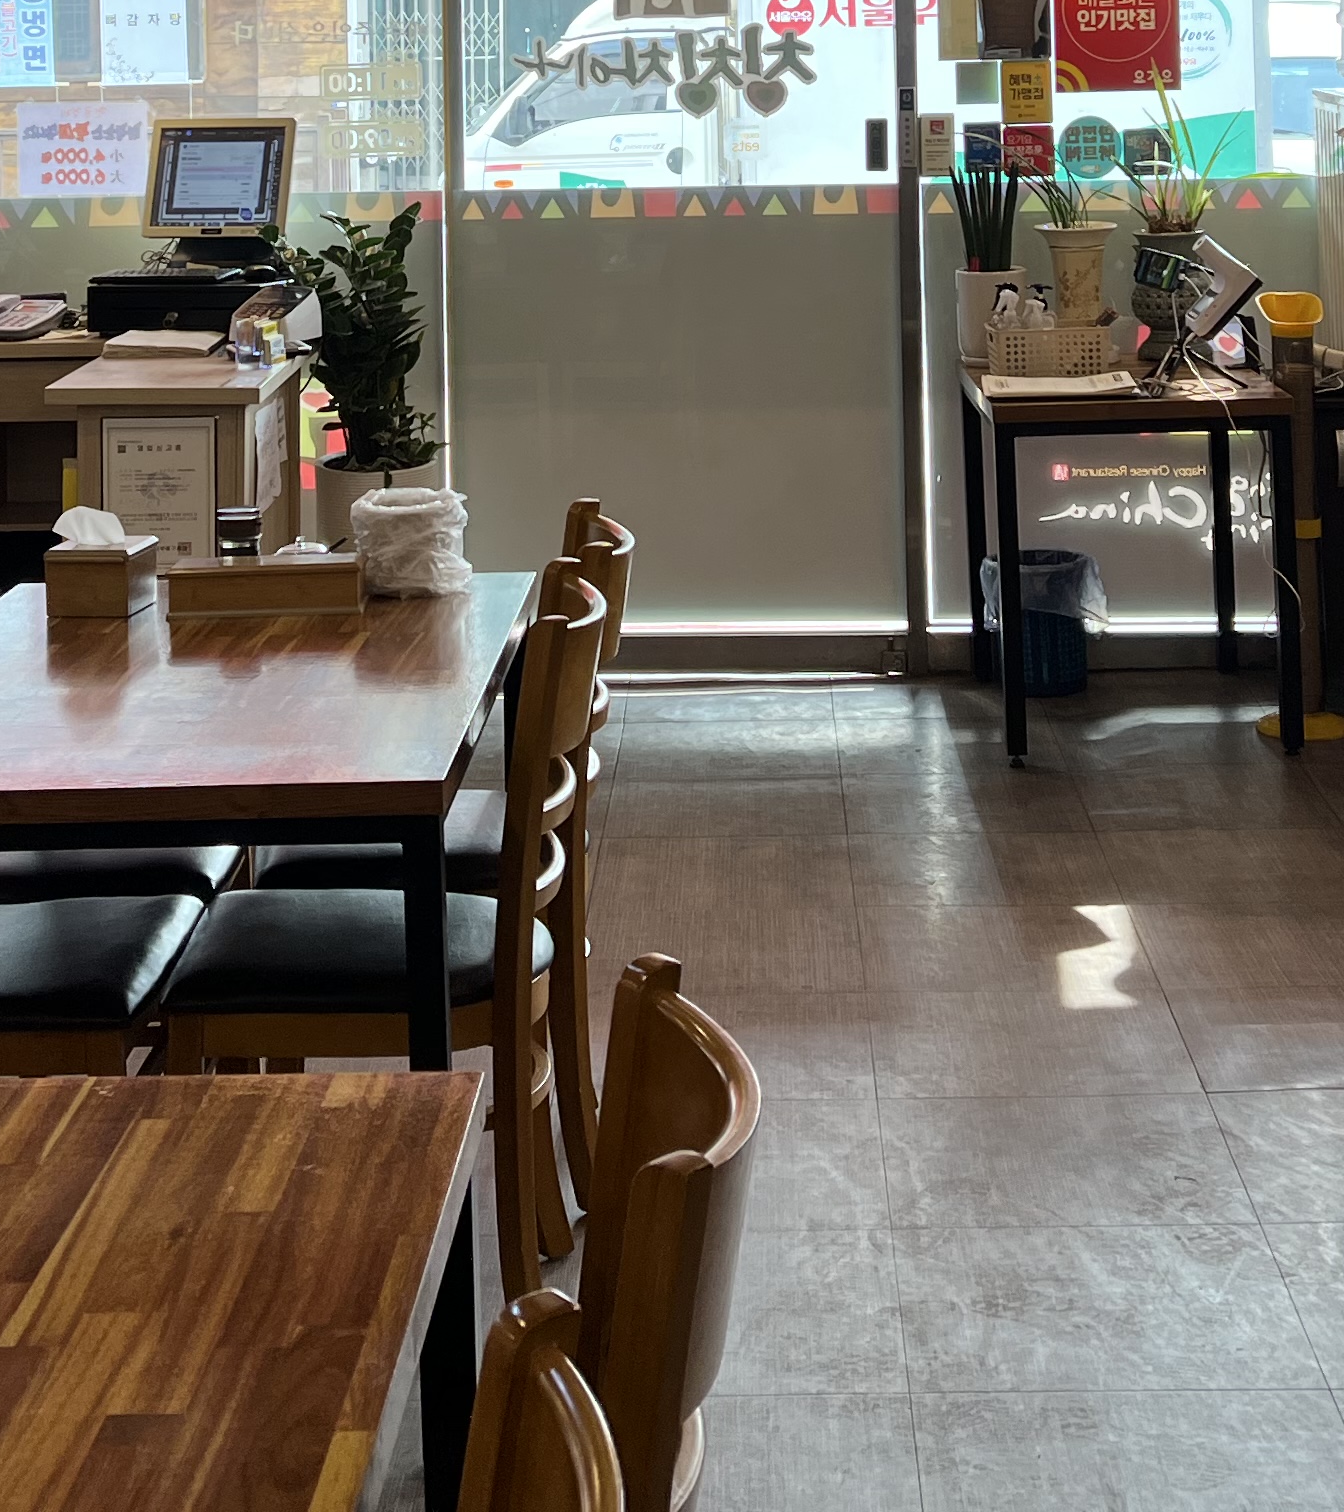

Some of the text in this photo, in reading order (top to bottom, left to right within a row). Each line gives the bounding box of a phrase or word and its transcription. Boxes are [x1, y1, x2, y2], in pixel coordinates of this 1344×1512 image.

[105, 12, 182, 27] 뼈감자탕
[1076, 8, 1157, 32] 인기맛집
[1009, 73, 1032, 86] 혜택
[1009, 88, 1044, 101] 가맹점
[1006, 134, 1033, 145] 요기요
